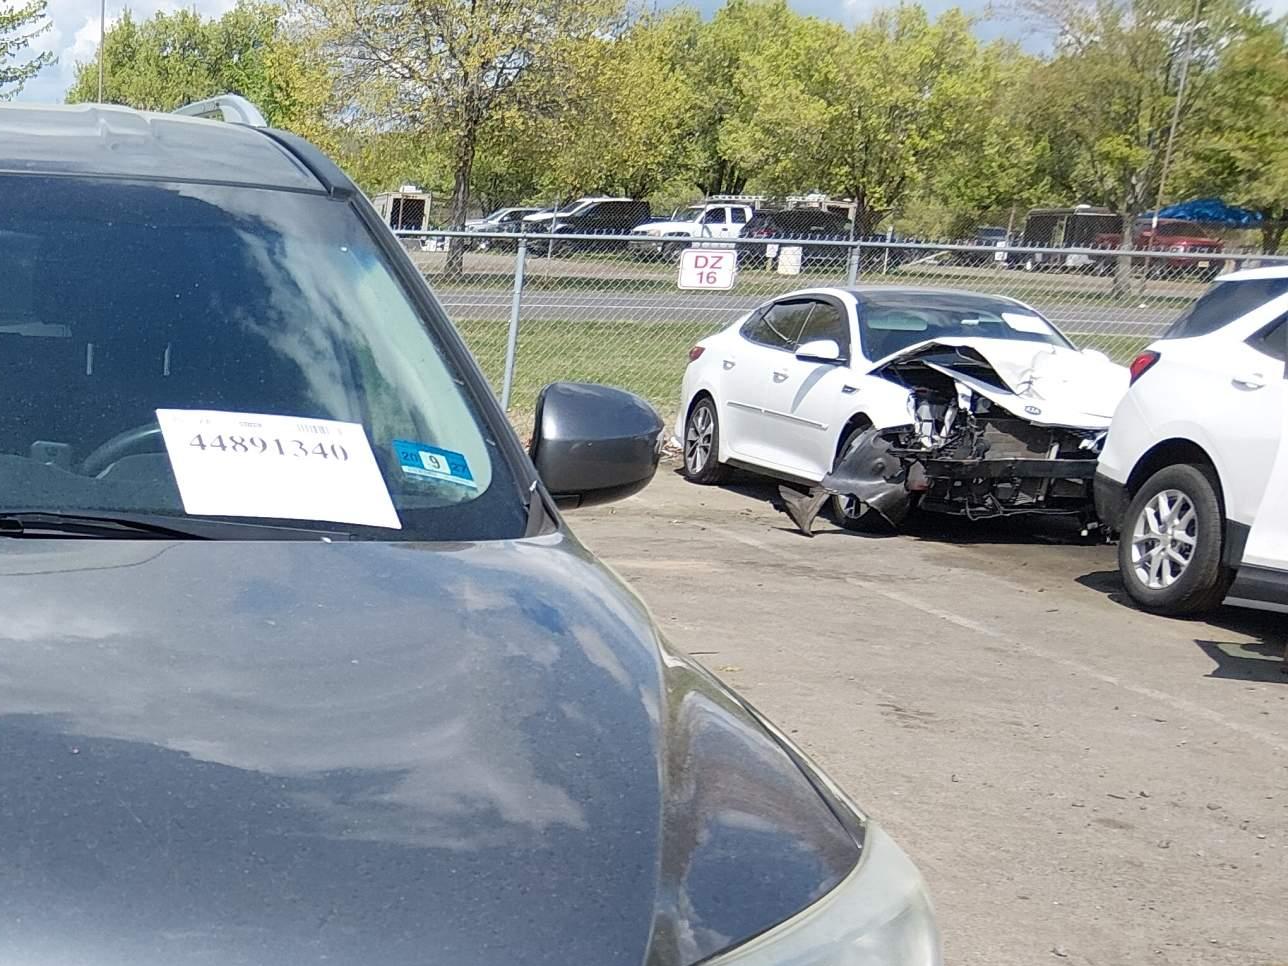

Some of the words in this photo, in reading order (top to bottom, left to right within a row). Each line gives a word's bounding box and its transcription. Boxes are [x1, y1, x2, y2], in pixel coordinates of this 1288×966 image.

[694, 255, 724, 269] DZ
[696, 271, 717, 285] 16
[189, 433, 349, 461] 44891340
[428, 455, 441, 470] 9
